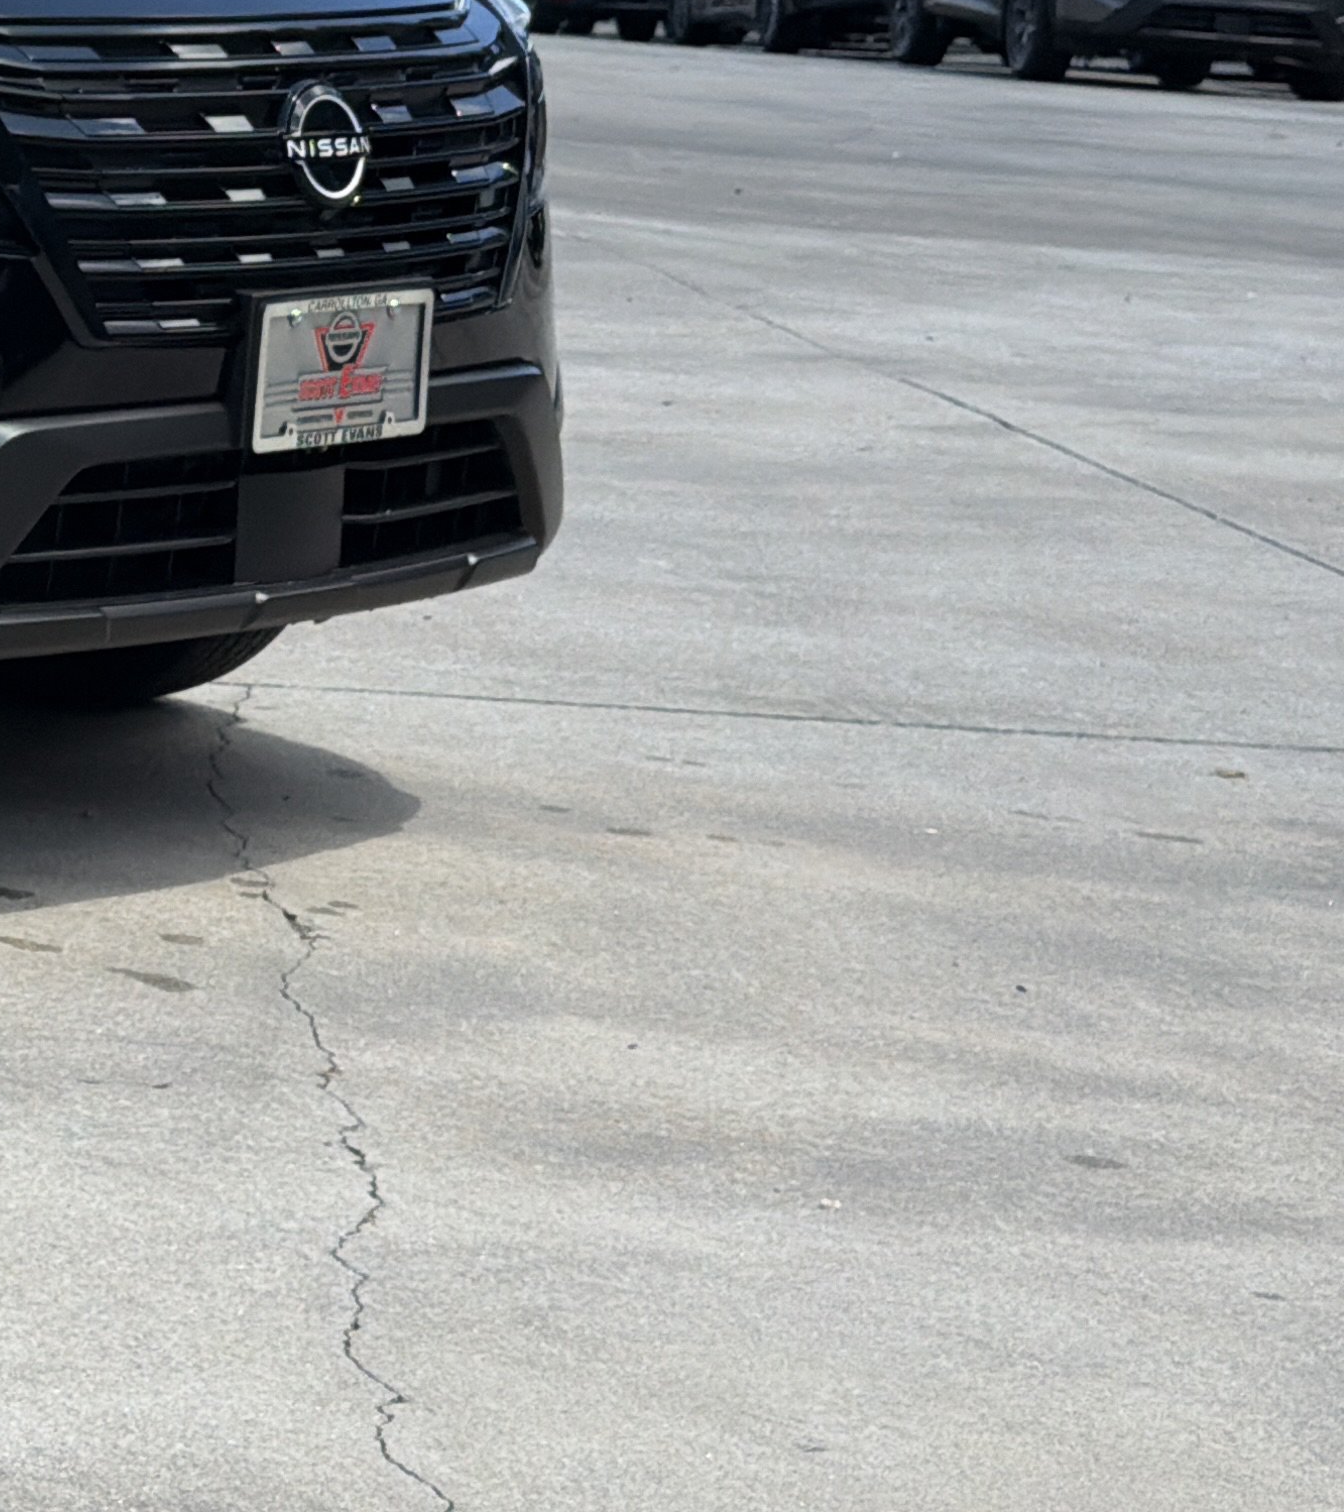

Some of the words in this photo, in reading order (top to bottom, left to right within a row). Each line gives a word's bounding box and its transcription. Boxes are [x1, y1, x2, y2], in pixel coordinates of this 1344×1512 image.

[286, 136, 372, 158] NISSAN
[296, 430, 337, 447] SCOTT
[342, 424, 383, 443] EVANS
